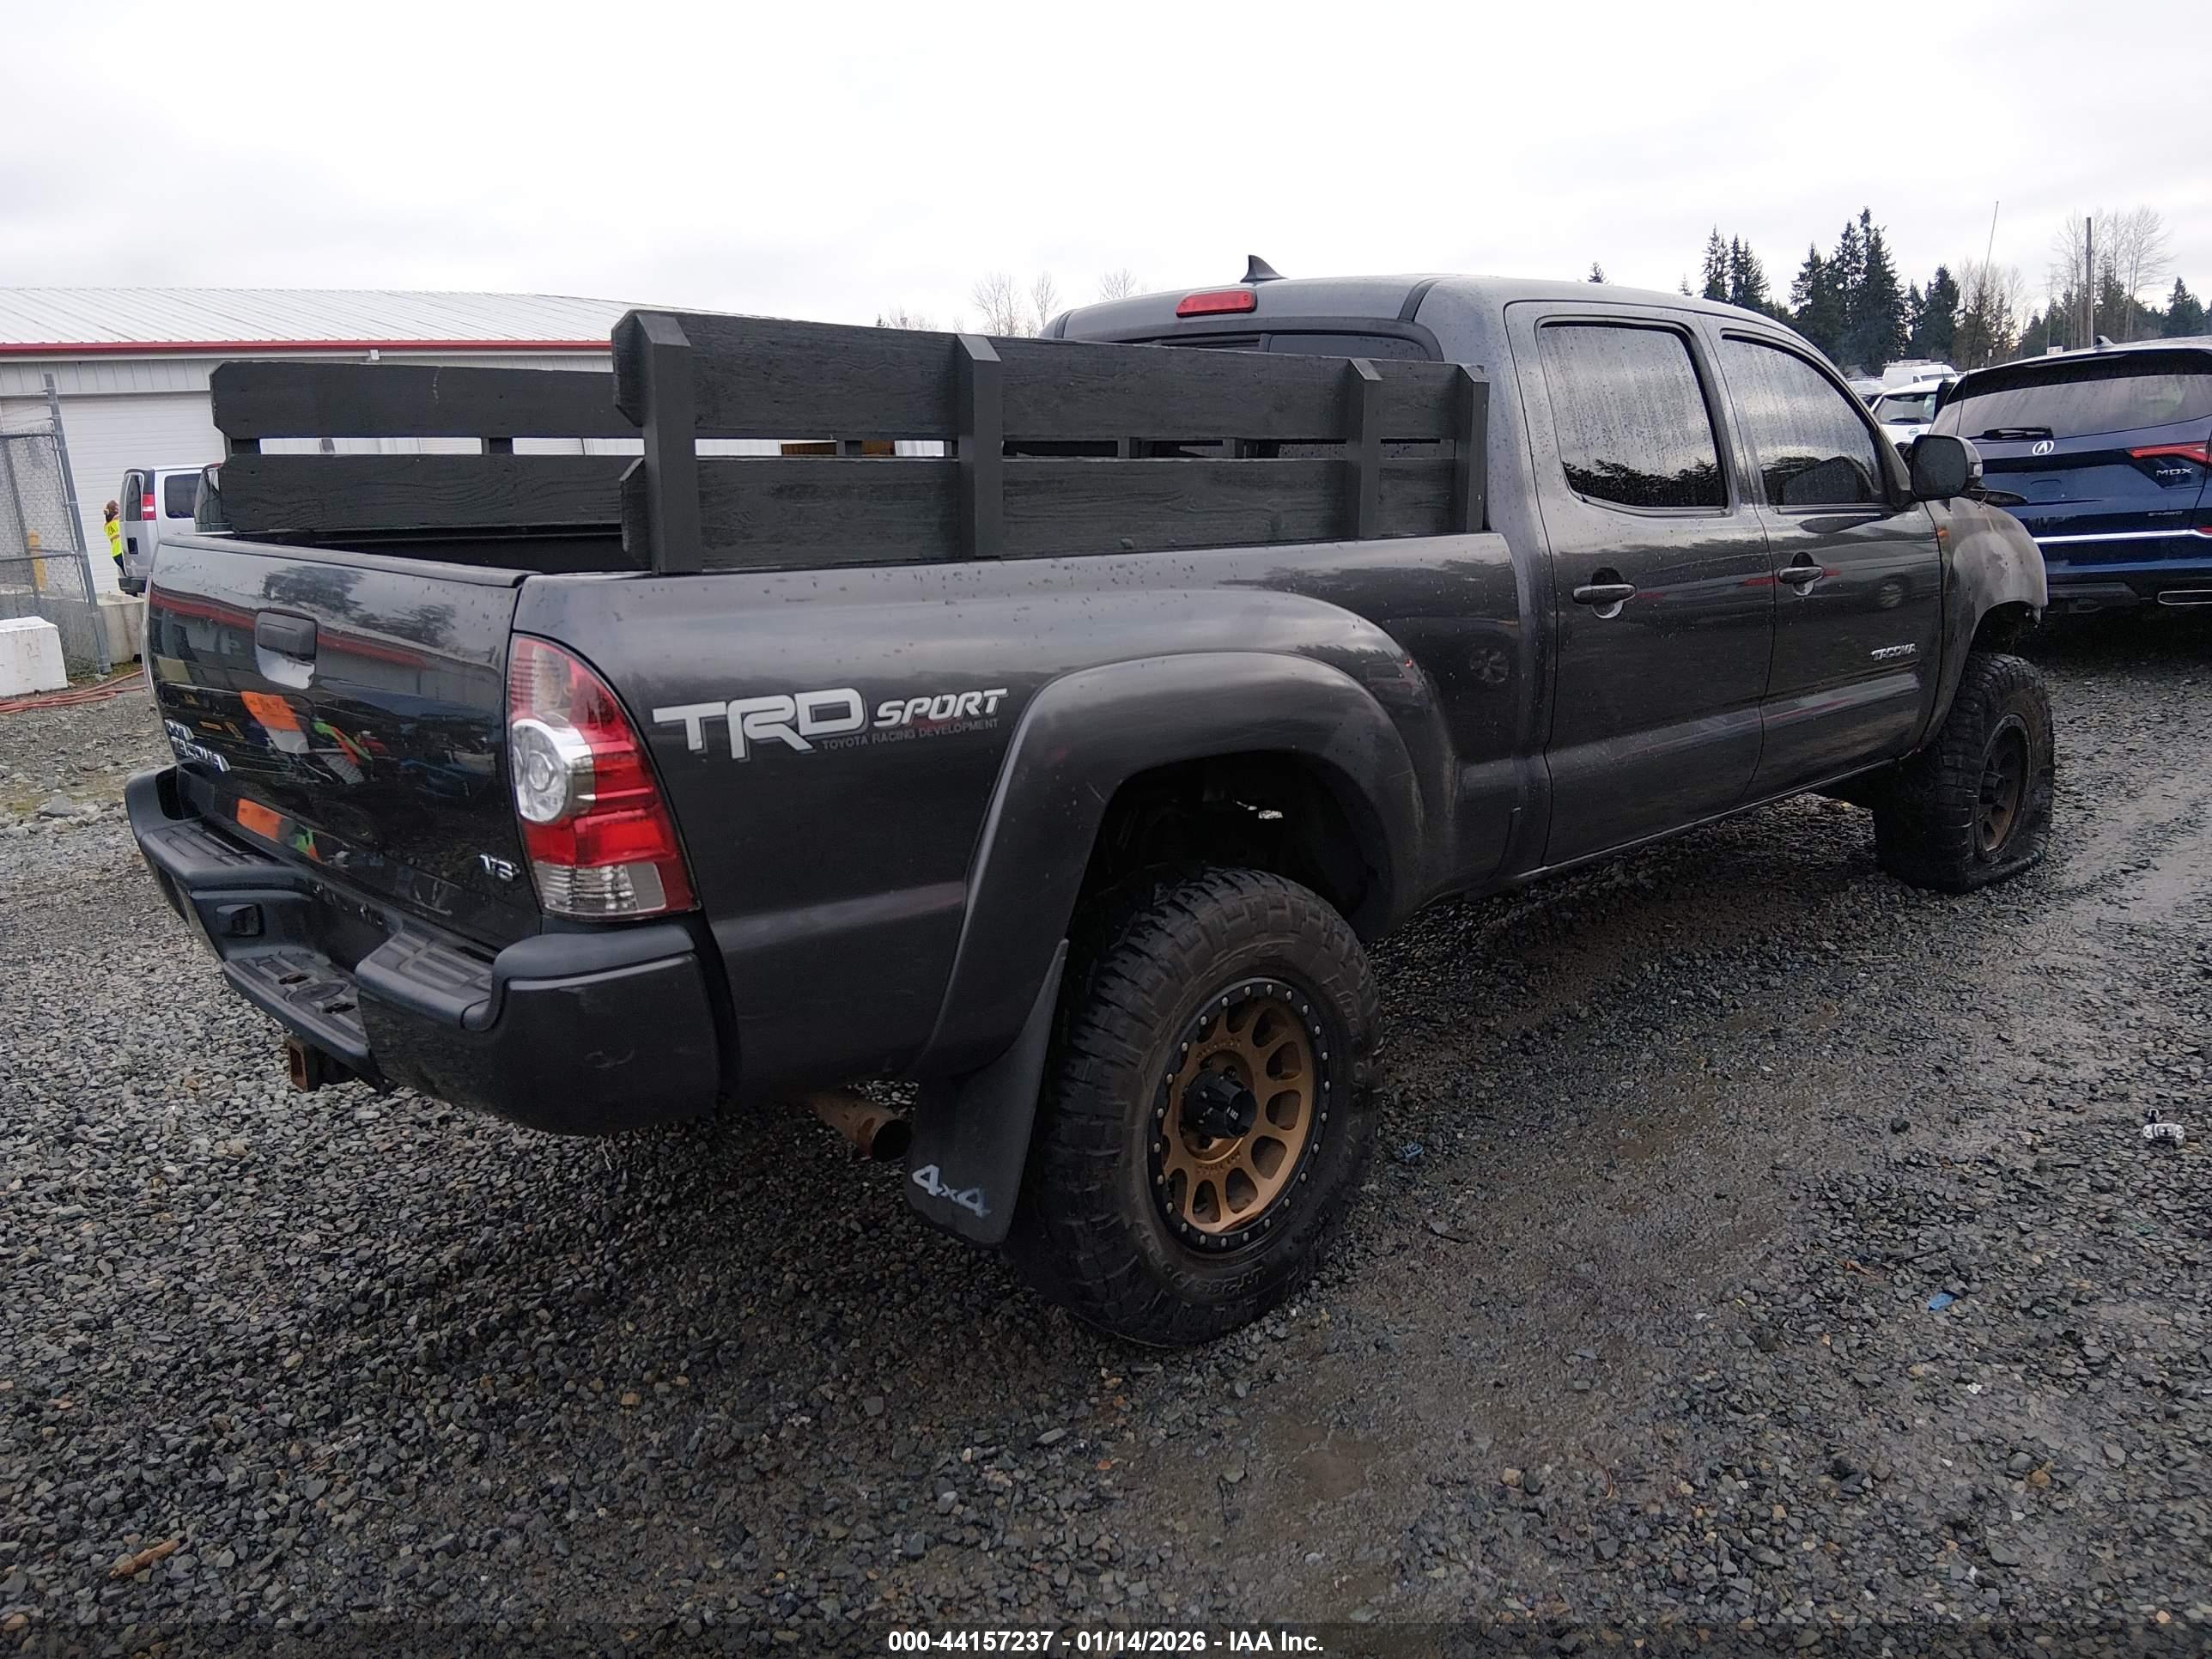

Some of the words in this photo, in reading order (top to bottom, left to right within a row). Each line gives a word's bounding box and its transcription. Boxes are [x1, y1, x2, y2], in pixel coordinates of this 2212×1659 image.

[1870, 643, 1916, 660] TACOMA
[653, 687, 867, 762] TRD
[873, 688, 1008, 727] SPORT
[822, 735, 869, 750] TOYOTA
[872, 727, 916, 744] RACING
[918, 718, 1000, 738] DEVELOPMENT
